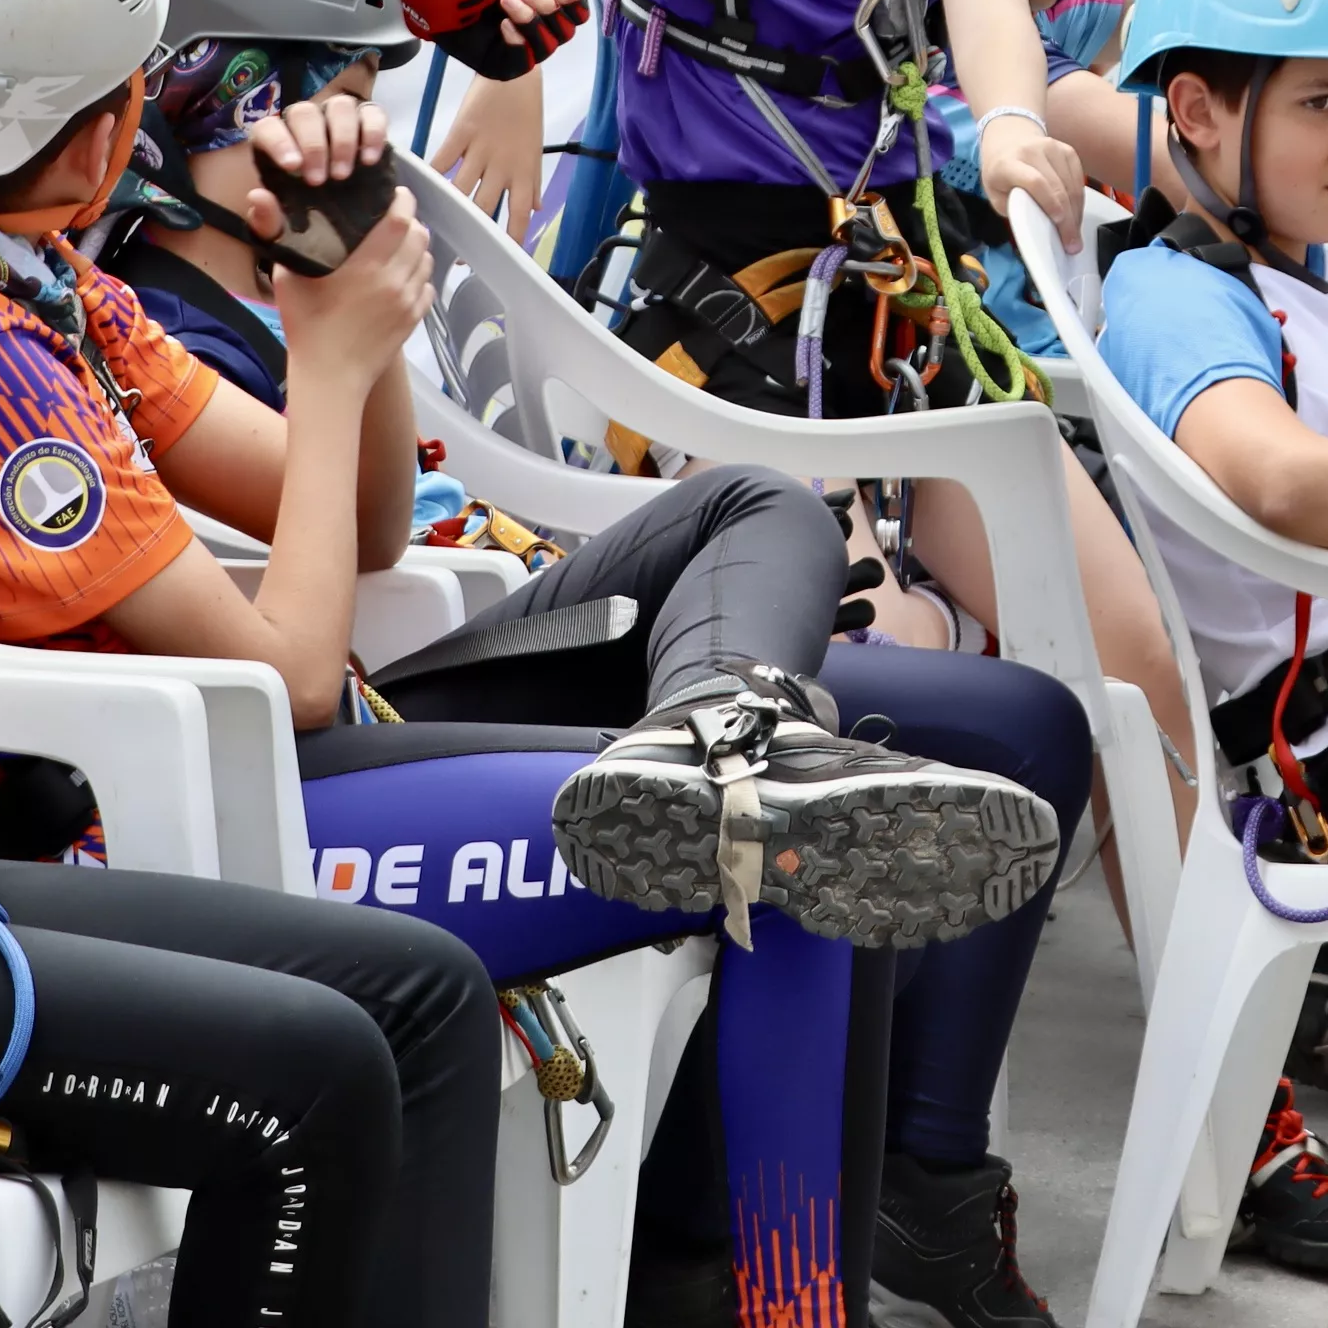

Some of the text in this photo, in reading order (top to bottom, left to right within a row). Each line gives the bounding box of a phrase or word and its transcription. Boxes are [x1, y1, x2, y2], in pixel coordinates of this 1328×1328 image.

[37, 446, 50, 456] de
[55, 507, 76, 526] FAE
[317, 838, 587, 905] DE ALI
